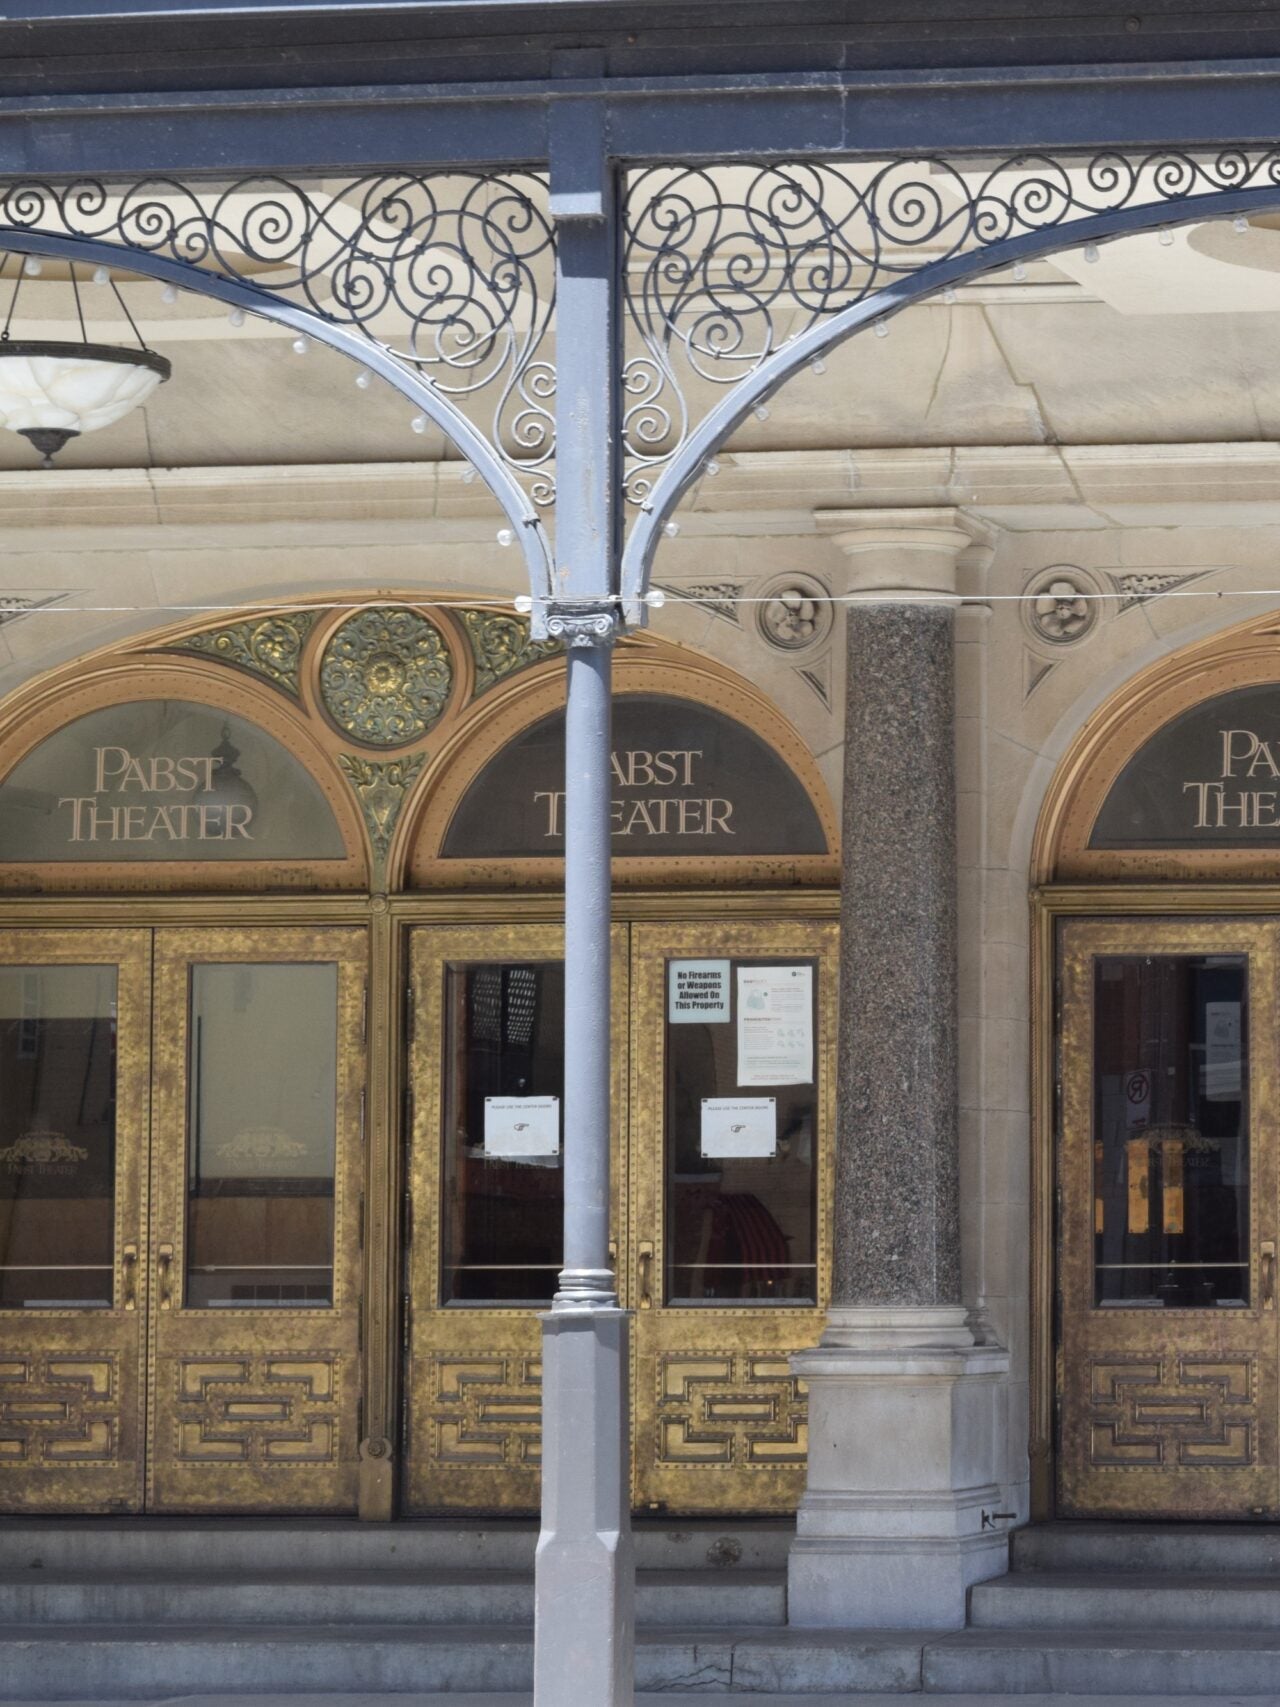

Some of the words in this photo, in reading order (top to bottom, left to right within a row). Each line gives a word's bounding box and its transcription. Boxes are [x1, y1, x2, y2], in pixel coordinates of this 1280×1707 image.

[93, 746, 224, 793] PABST
[610, 750, 703, 786] ABST
[58, 796, 255, 842] THEATER
[534, 791, 736, 836] TEATER
[677, 971, 687, 980] No
[689, 970, 721, 979] Firearms
[687, 981, 721, 990] Weapons
[675, 1001, 691, 1010] This
[692, 1001, 724, 1010] Property
[679, 991, 709, 999] Allowed
[710, 990, 720, 999] On
